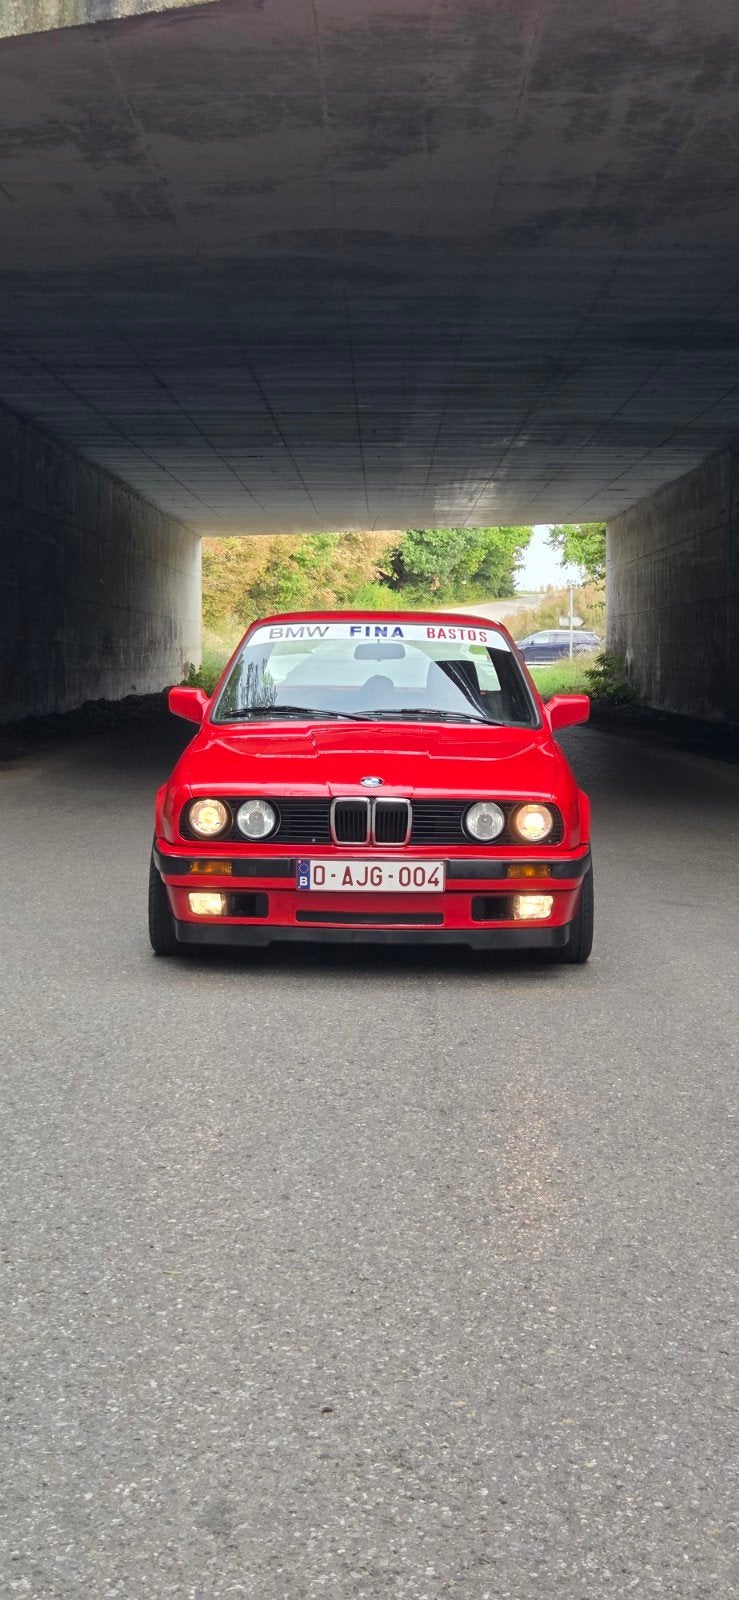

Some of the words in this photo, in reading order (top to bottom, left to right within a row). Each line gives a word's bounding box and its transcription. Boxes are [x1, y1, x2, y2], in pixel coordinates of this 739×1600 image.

[268, 626, 330, 639] BMW
[349, 626, 405, 638] FINA
[426, 627, 488, 643] BASTOS
[299, 876, 308, 886] B
